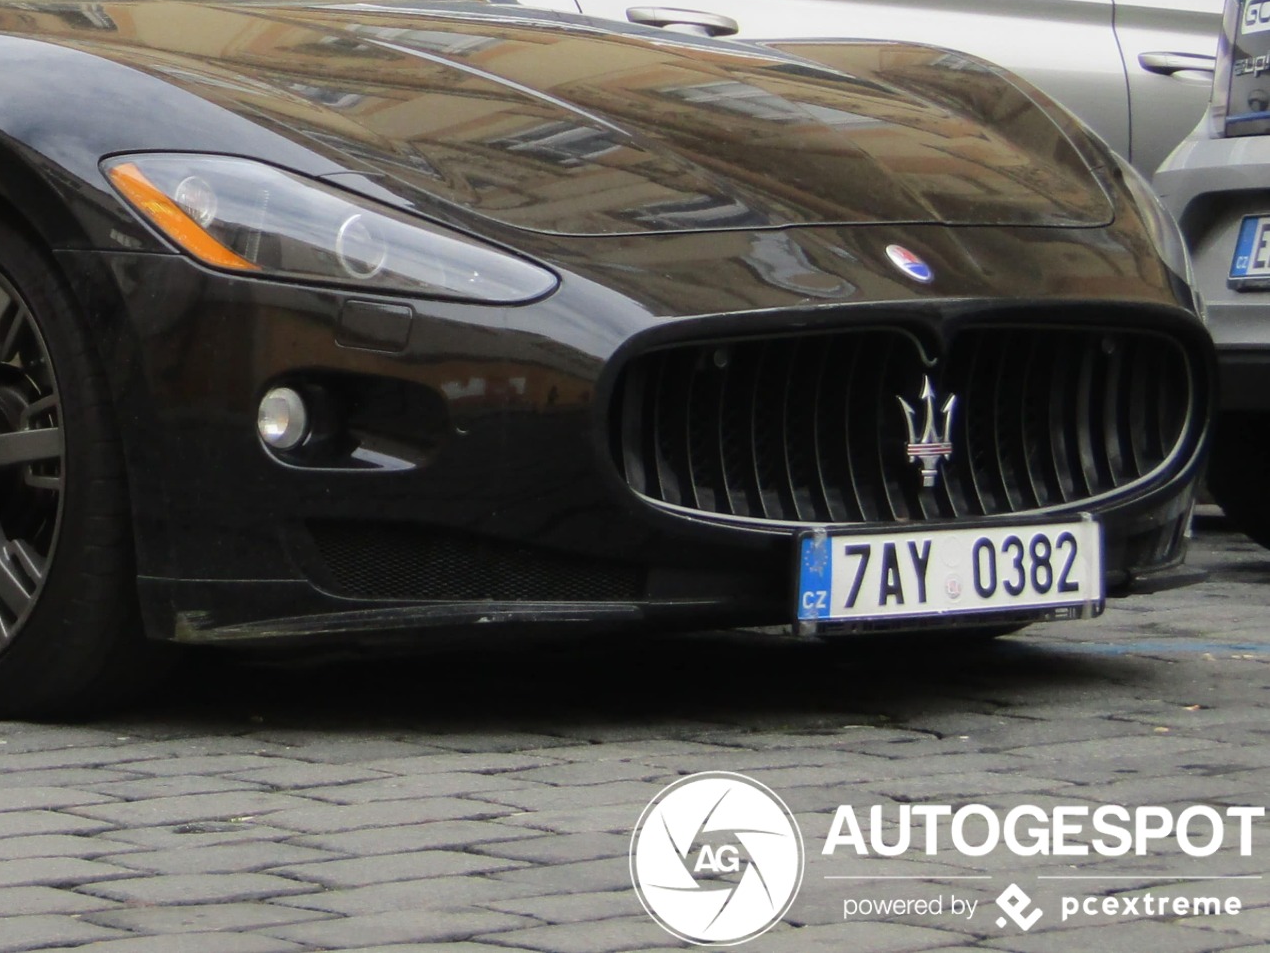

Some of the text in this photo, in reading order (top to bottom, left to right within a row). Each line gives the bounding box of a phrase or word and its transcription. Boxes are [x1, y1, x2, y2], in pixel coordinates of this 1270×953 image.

[844, 531, 1080, 609] 7AY 0382
[802, 590, 827, 610] CZ
